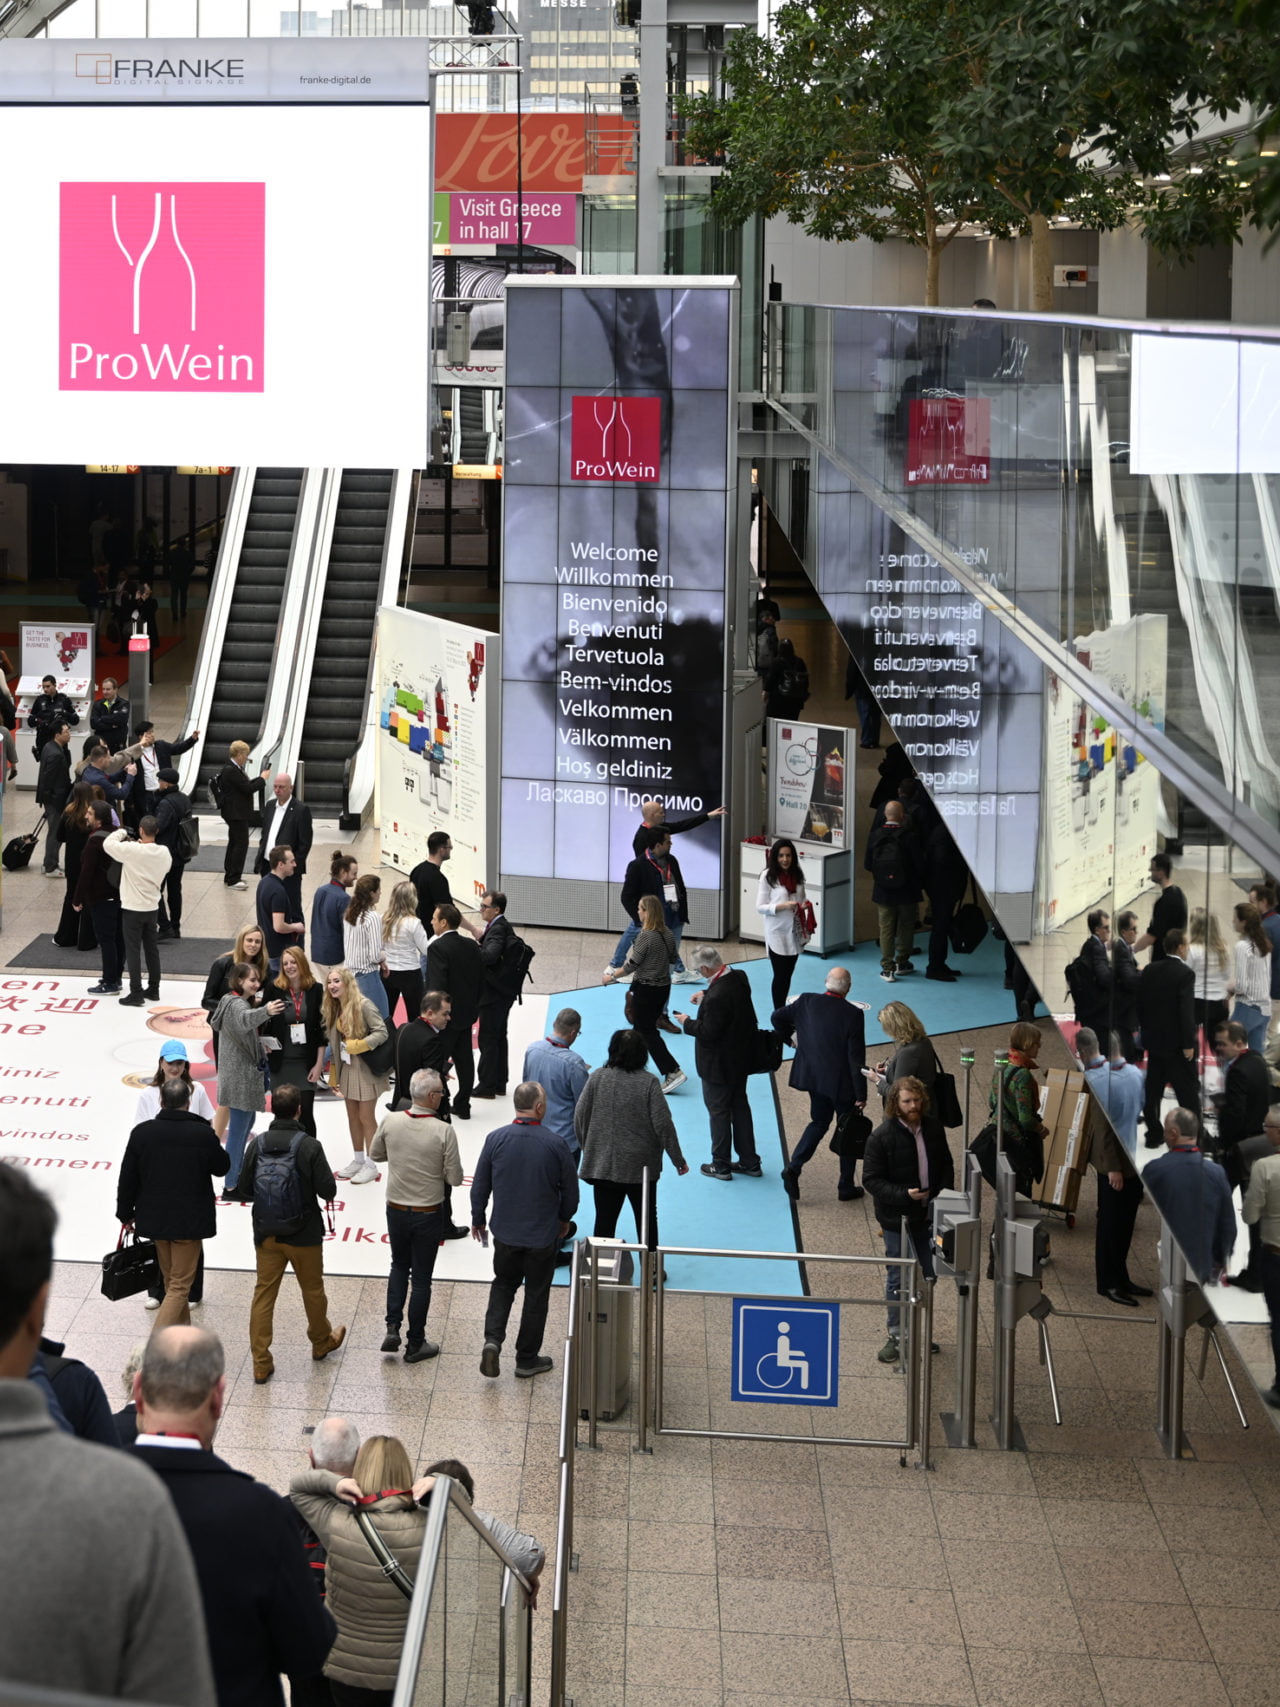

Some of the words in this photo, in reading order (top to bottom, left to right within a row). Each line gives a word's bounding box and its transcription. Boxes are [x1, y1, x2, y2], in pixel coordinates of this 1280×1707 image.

[113, 59, 244, 78] FRANKE
[299, 76, 372, 86] franke-digital.de
[459, 198, 496, 217] Visit
[500, 198, 562, 217] Greece
[459, 221, 474, 239] in
[479, 221, 509, 239] hall
[70, 342, 254, 381] ProWein
[575, 460, 655, 478] ProWein
[570, 542, 658, 562] Welcome
[554, 566, 674, 588] Willkommen
[562, 592, 667, 614] Bienvenido
[568, 619, 662, 640] Benvenuti
[565, 644, 665, 666] Tervetuola
[560, 670, 673, 694] Bem-vindos
[559, 698, 673, 722] Velkommen
[559, 727, 672, 751] Välkommen
[557, 756, 592, 779] Hoş
[596, 759, 673, 780] geldiniz
[526, 782, 607, 806] Ласкаво
[614, 787, 703, 812] Просимо
